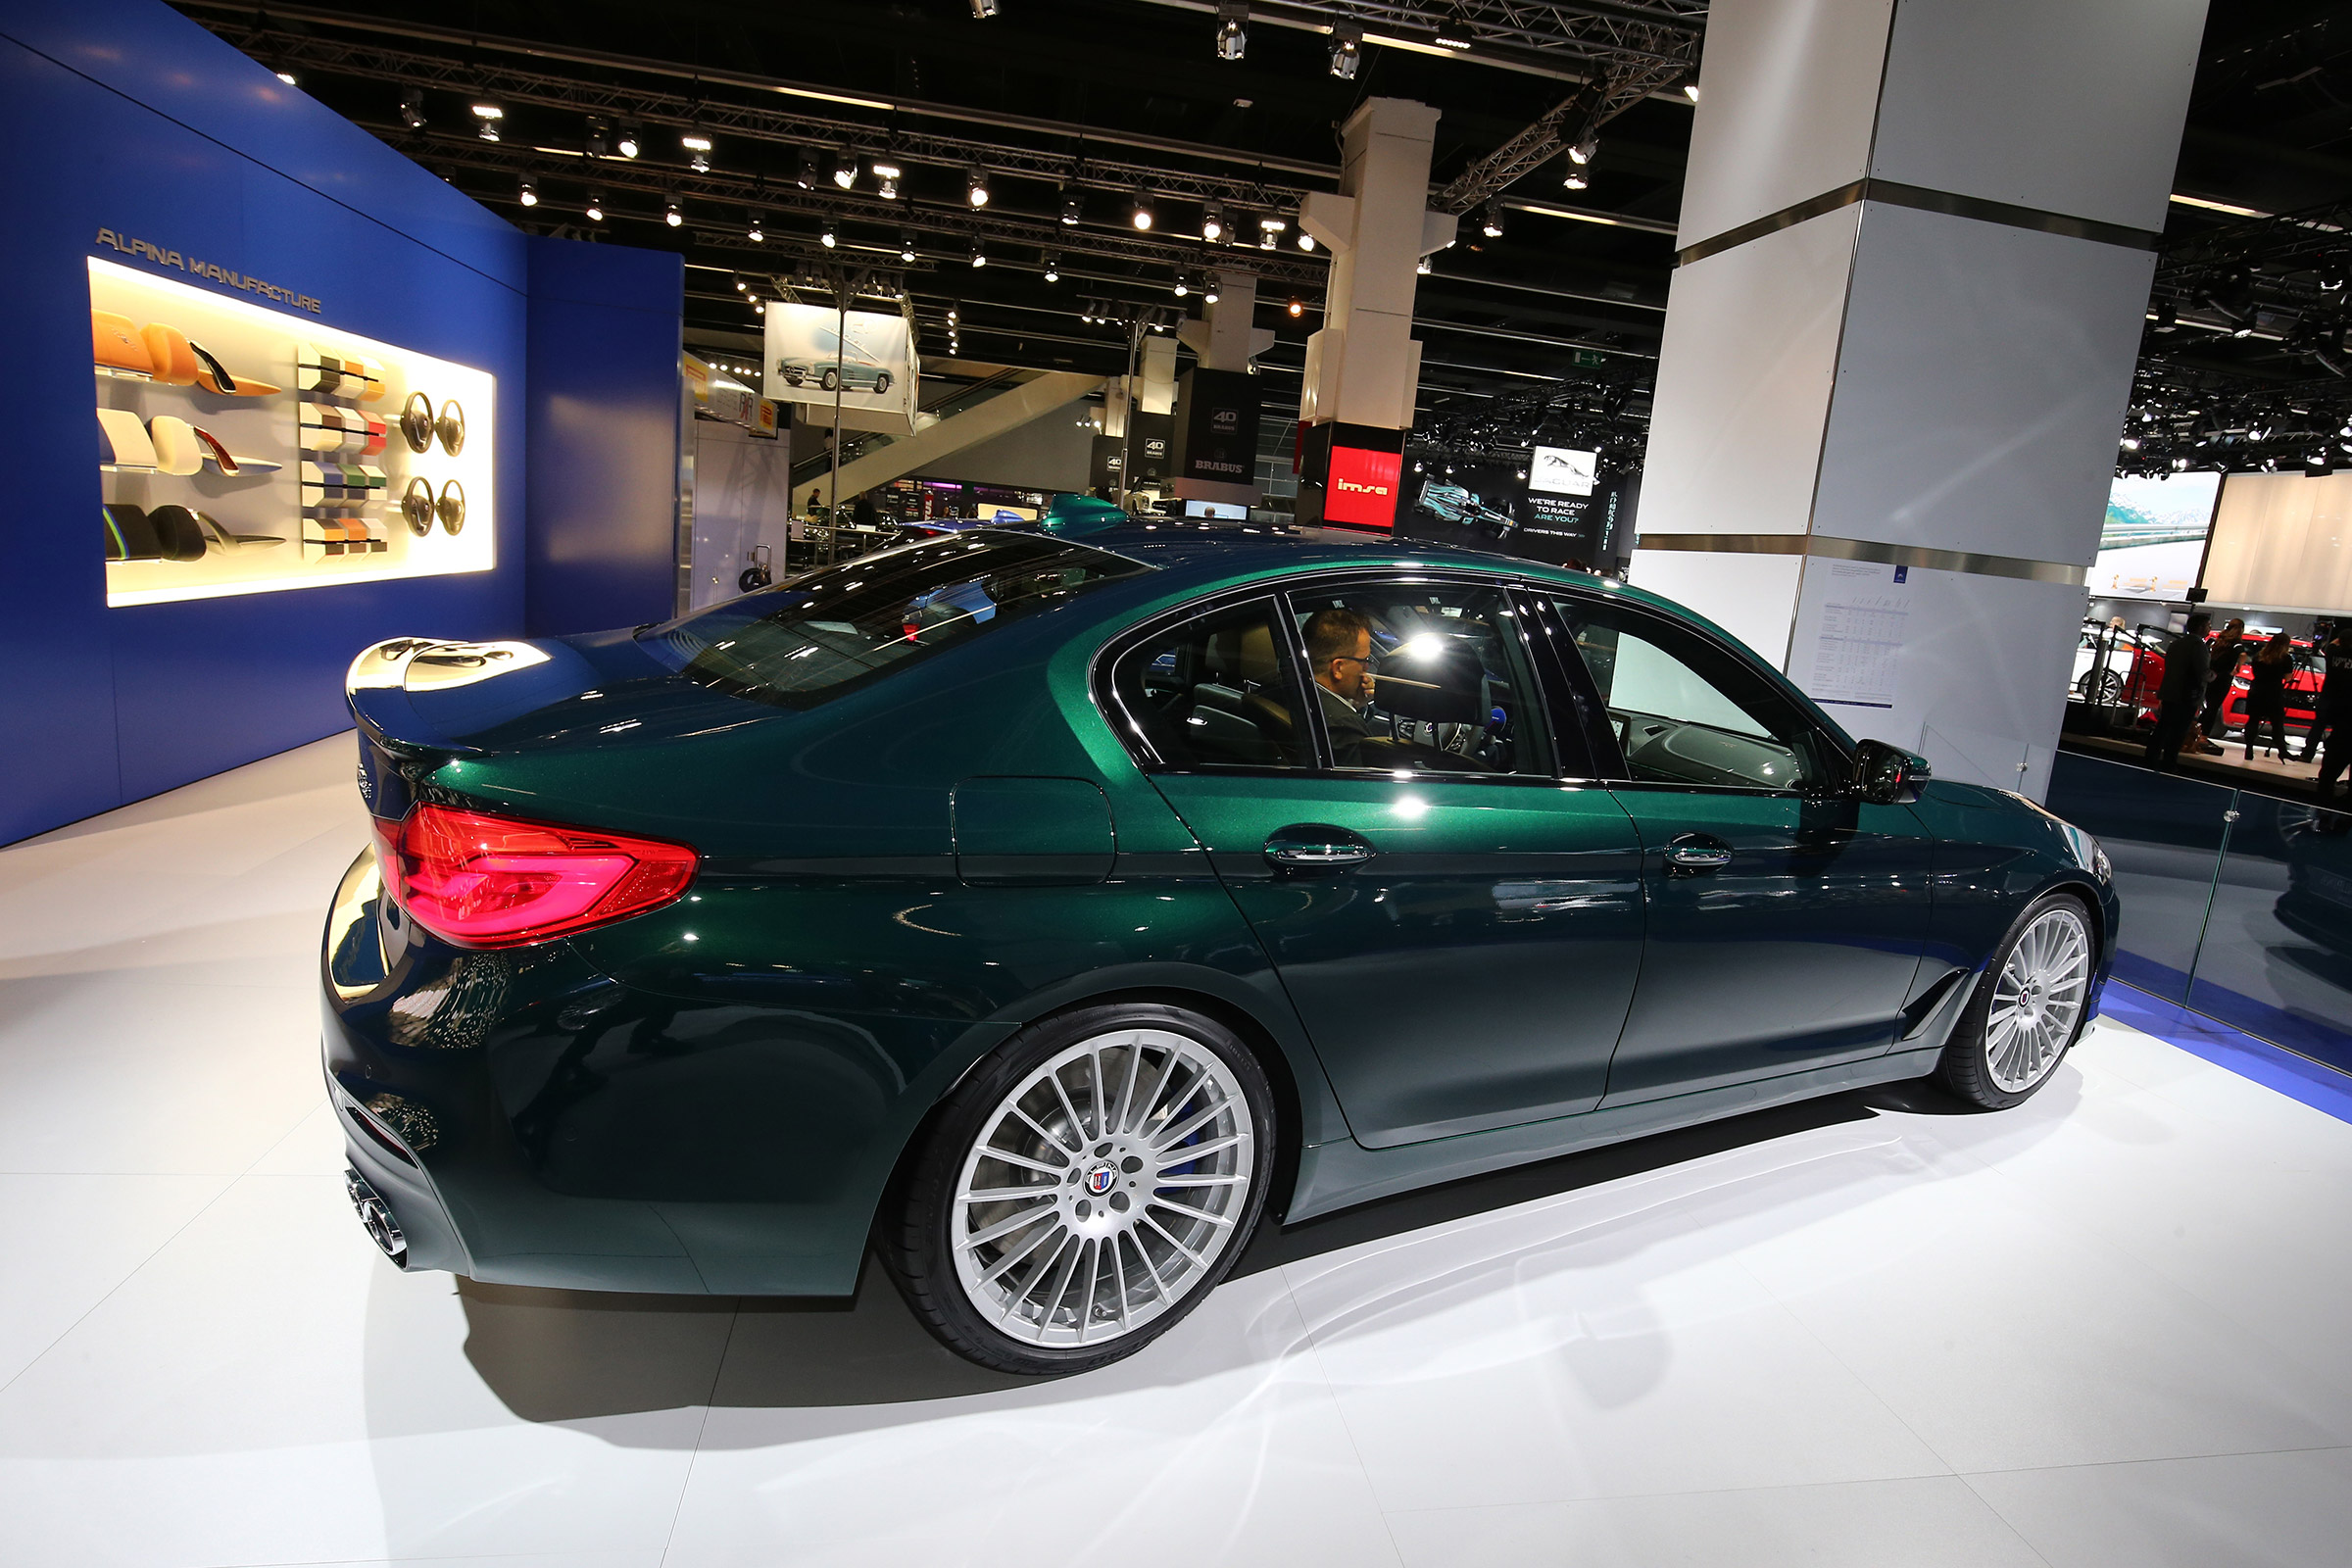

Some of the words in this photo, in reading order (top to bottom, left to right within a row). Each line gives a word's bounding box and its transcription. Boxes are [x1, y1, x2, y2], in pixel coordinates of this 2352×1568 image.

[95, 227, 185, 271] ALPINA
[188, 257, 321, 315] MANUFACTURE
[1213, 411, 1237, 422] 40
[1147, 441, 1164, 450] 40
[1196, 460, 1243, 473] BRABUS
[1338, 478, 1388, 496] imsa
[1528, 497, 1556, 507] WE'RE
[1557, 500, 1589, 510] READY
[1550, 507, 1575, 515] RACE
[1554, 514, 1579, 523] YOU?
